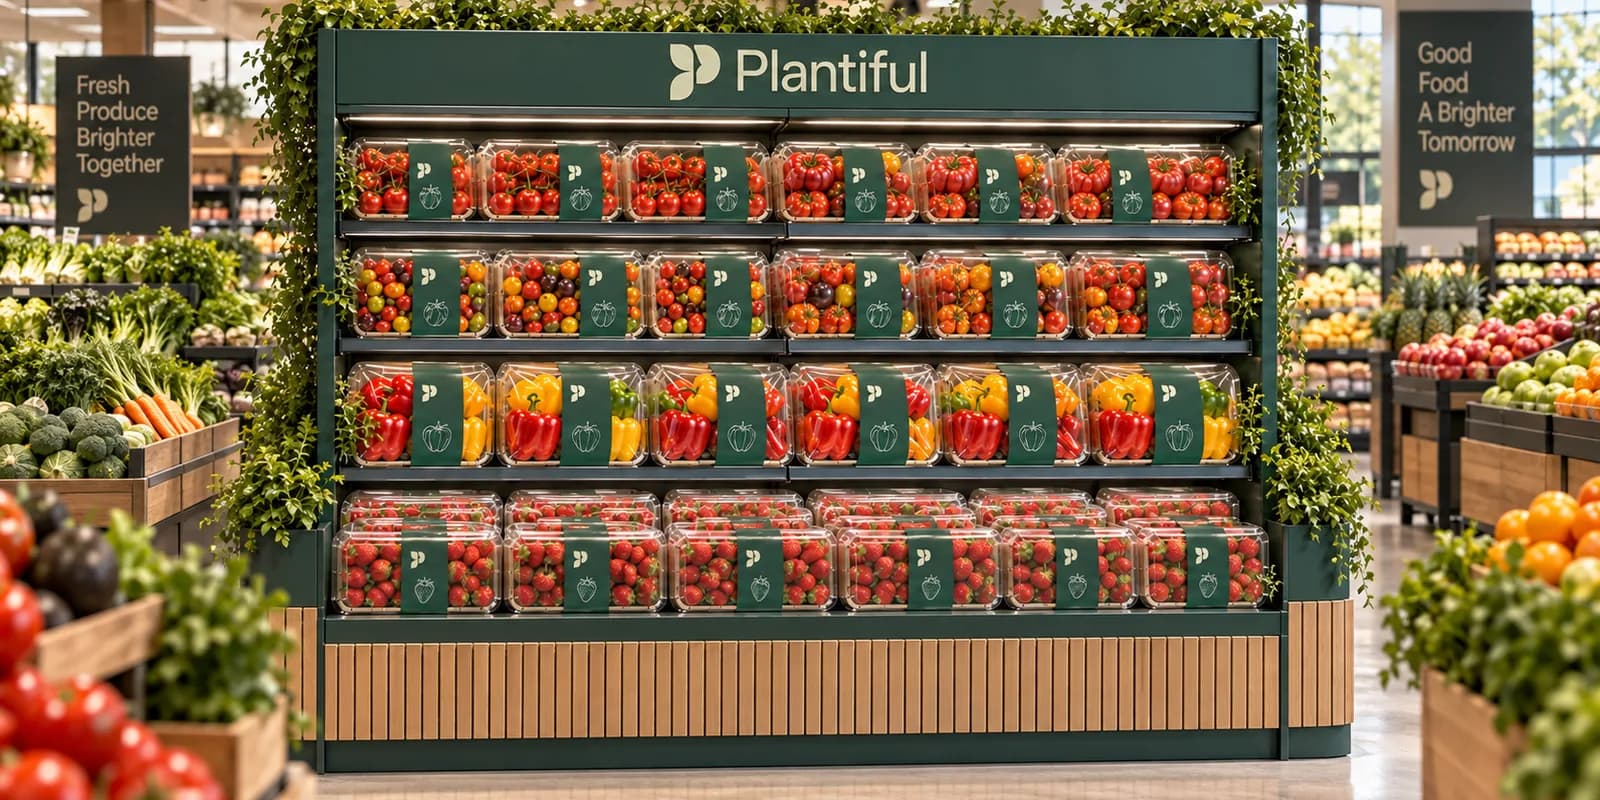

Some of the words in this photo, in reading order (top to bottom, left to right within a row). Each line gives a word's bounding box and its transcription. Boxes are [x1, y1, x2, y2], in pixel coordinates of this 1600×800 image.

[1418, 41, 1472, 64] Good
[737, 48, 927, 94] Plantiful
[1419, 71, 1469, 94] Food
[76, 74, 130, 95] Fresh
[76, 100, 159, 121] Produce
[1418, 102, 1433, 123] A
[1438, 101, 1516, 127] Brighter
[76, 127, 156, 150] Brighter
[1418, 130, 1516, 153] Tomorrow
[76, 152, 164, 178] Together
